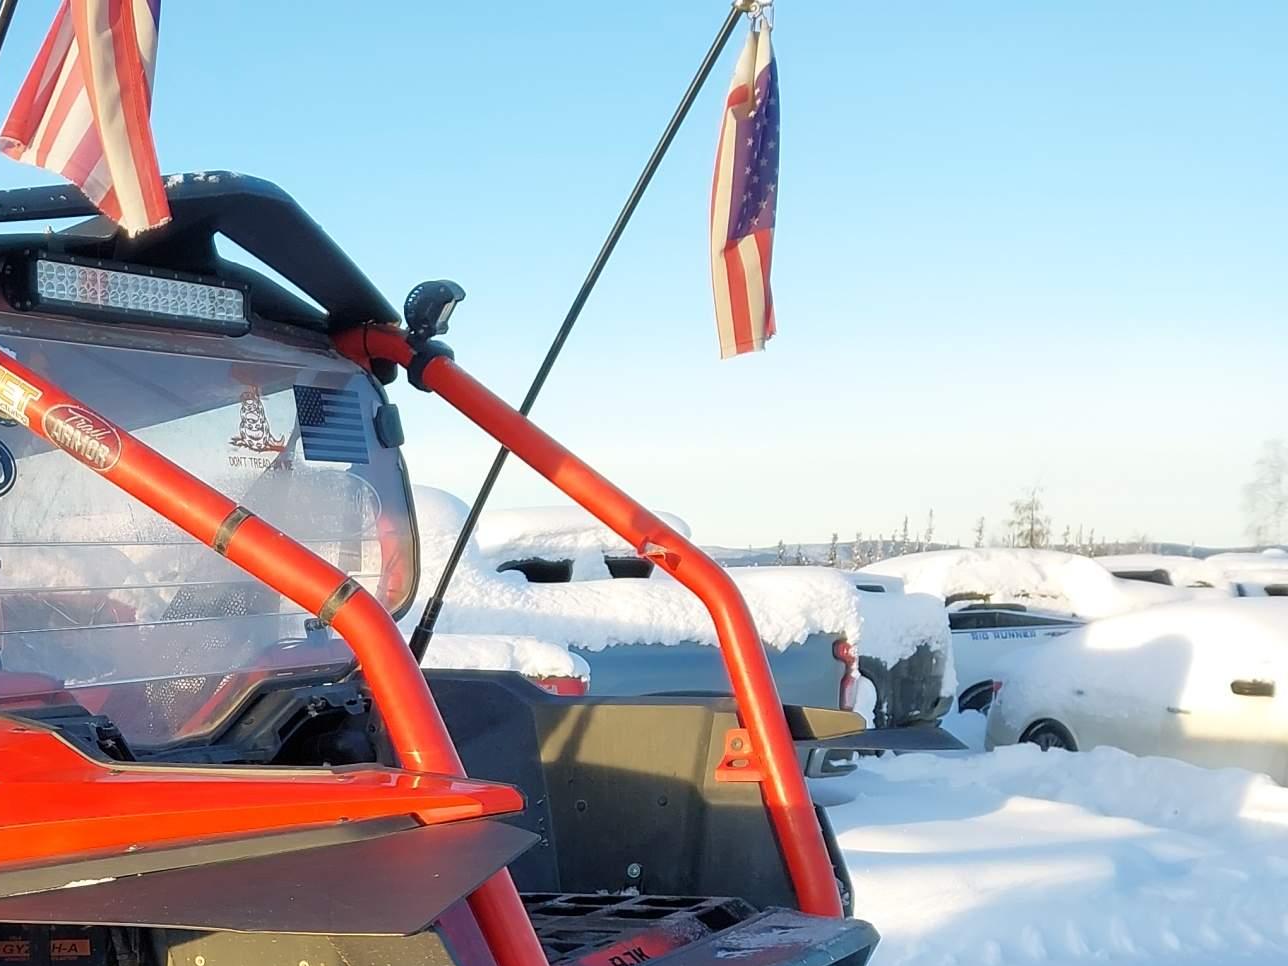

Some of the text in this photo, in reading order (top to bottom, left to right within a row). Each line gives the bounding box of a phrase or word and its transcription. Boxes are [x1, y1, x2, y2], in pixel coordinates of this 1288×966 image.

[51, 419, 110, 468] ARMOR
[228, 456, 246, 467] DON'T
[249, 457, 271, 469] TREAD
